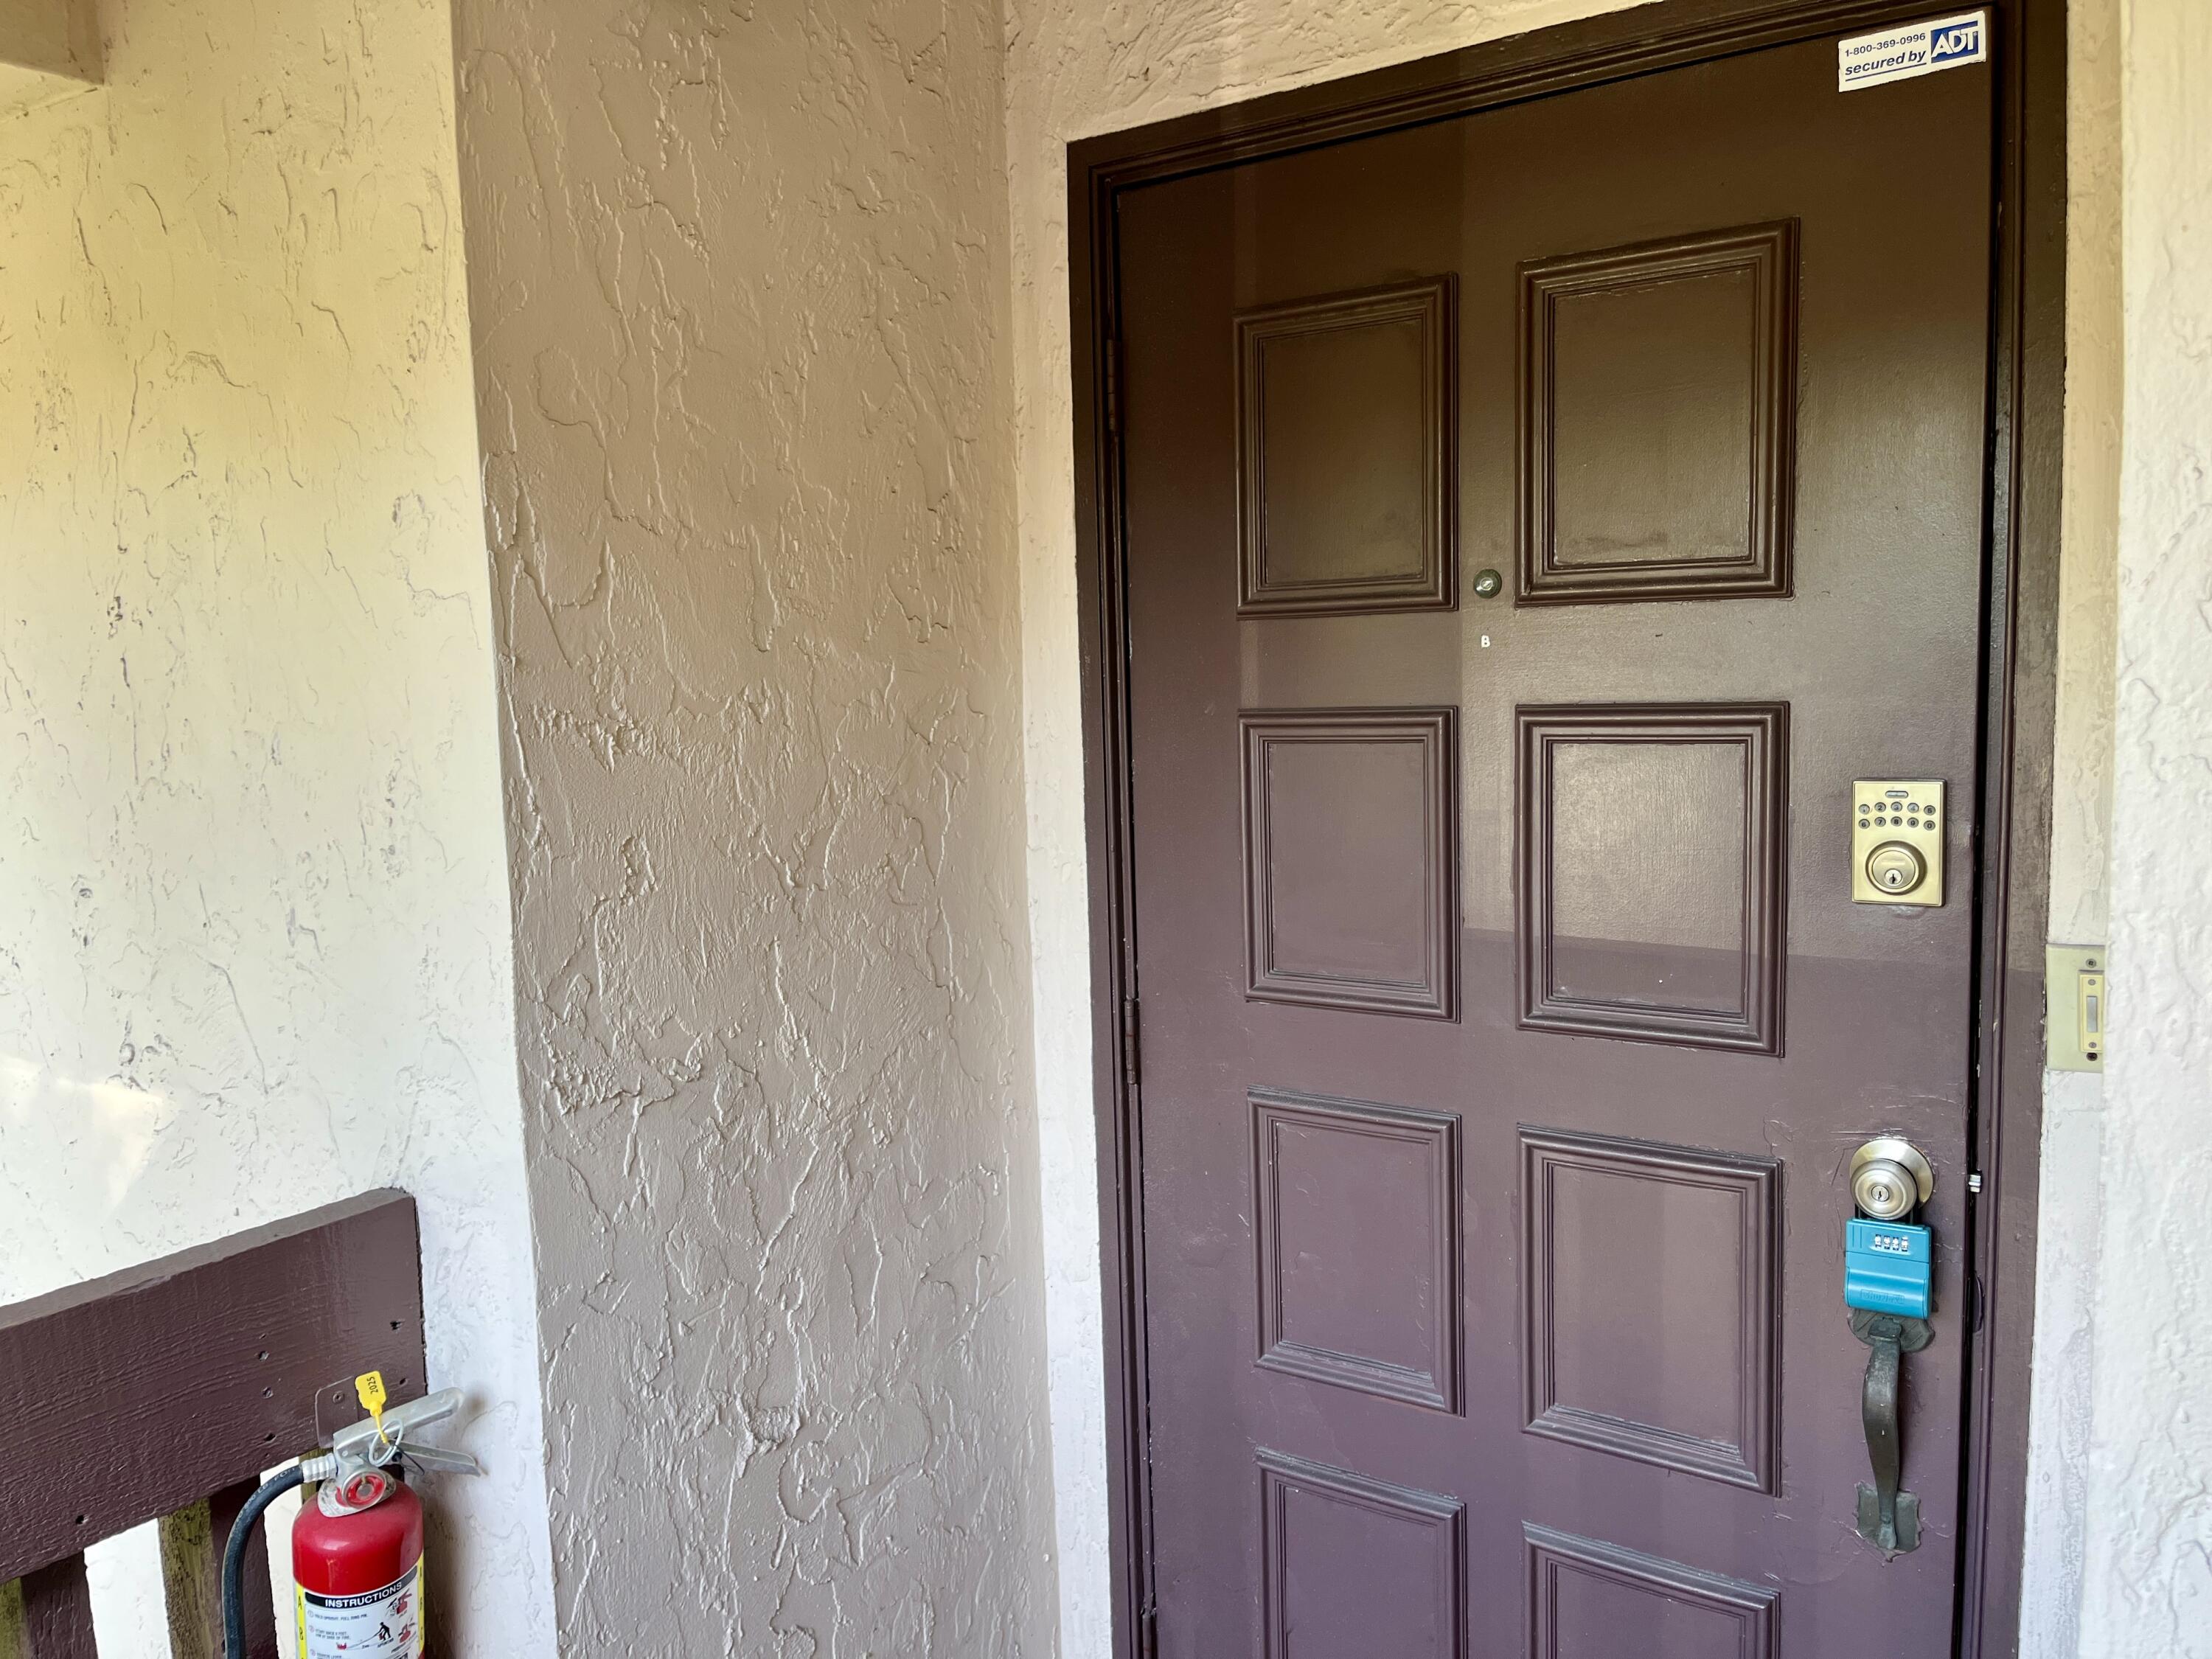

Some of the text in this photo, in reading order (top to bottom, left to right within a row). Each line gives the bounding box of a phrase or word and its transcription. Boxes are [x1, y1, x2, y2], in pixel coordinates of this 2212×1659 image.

[1845, 28, 1979, 75] secured by ADT
[1846, 33, 1926, 57] 1-800-369-0996
[1481, 635, 1490, 648] B
[367, 1377, 378, 1394] 2025
[298, 1596, 302, 1610] A
[325, 1582, 402, 1607] INSTRUCTIONS
